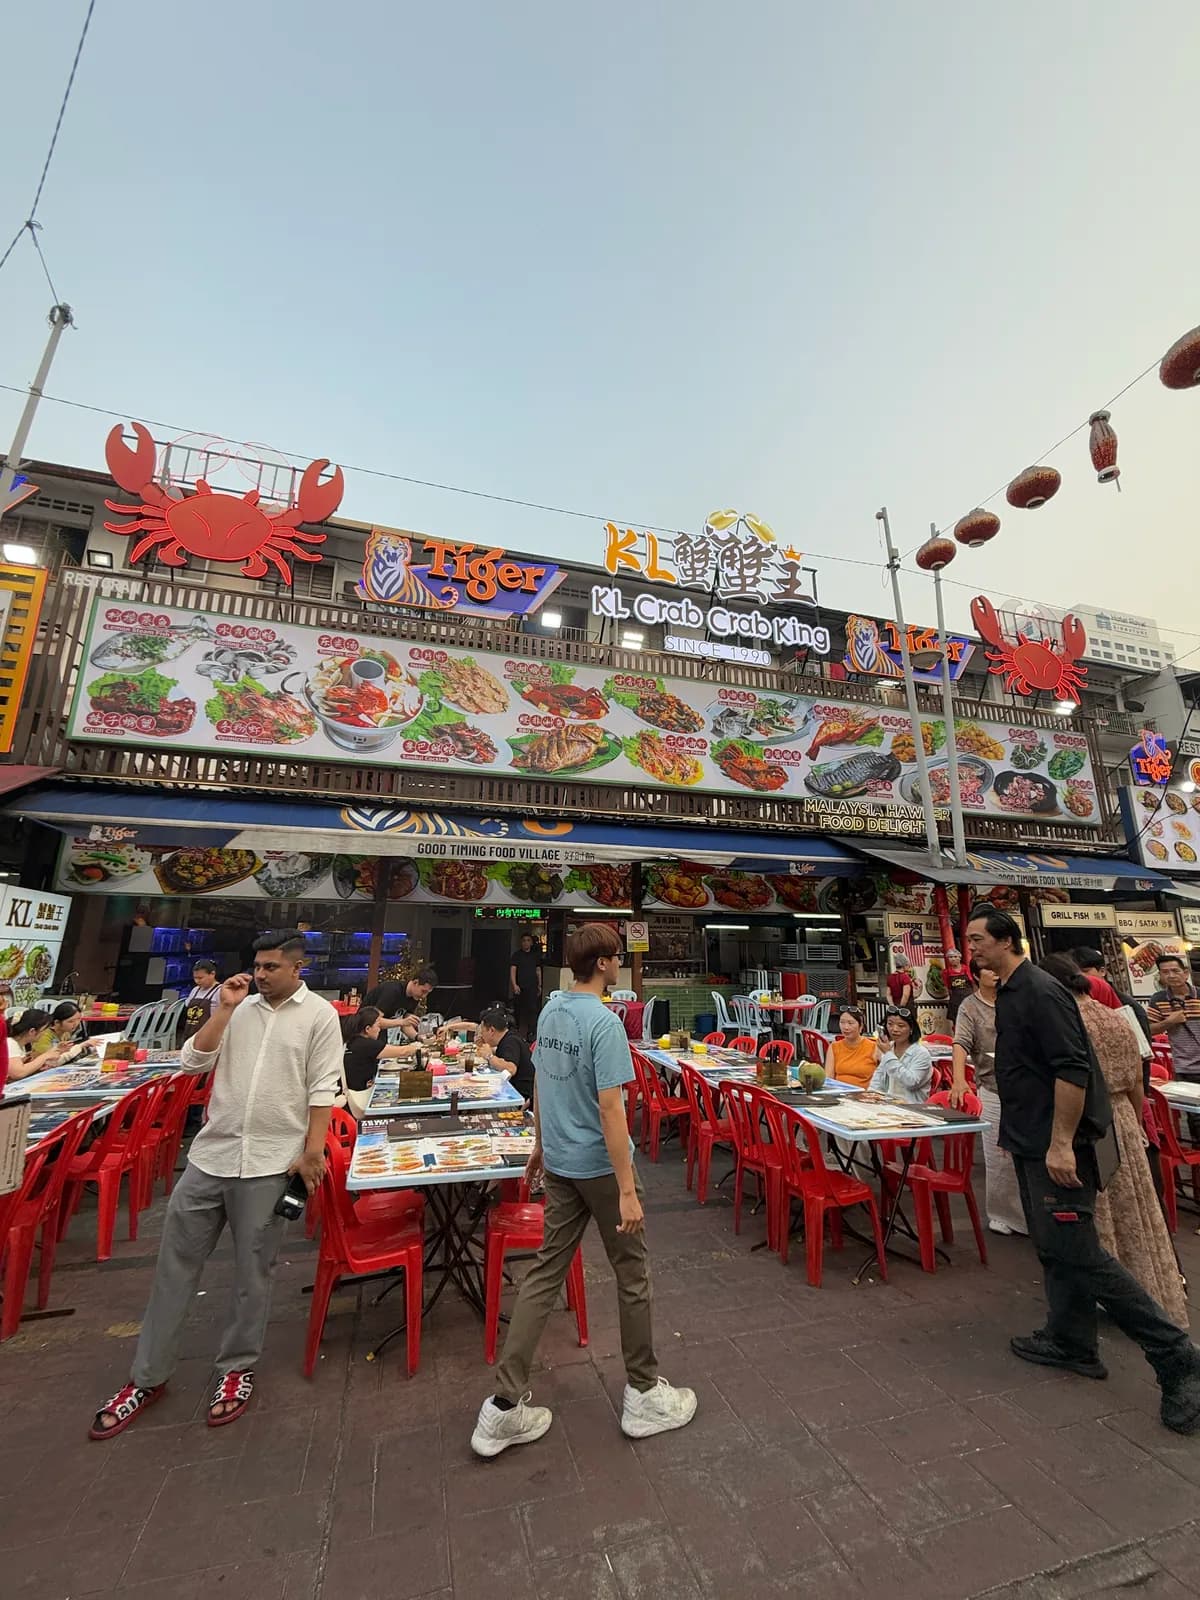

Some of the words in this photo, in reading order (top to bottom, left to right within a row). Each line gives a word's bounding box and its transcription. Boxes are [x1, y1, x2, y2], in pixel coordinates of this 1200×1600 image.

[604, 521, 676, 584] KL
[424, 540, 546, 600] Tiger
[592, 586, 630, 618] KL
[634, 594, 703, 627] Crab
[707, 606, 772, 639] Crab
[773, 616, 830, 654] King
[665, 636, 721, 657] SINCE
[730, 646, 771, 665] 1990
[1137, 757, 1172, 782] Tiger
[805, 799, 883, 816] MALAYSIA
[887, 804, 950, 820] HAWER
[104, 826, 139, 841] Tiger
[820, 815, 864, 831] FOOD
[417, 842, 447, 856] GOOD
[450, 844, 487, 857] TIMING
[489, 846, 516, 859] FOOD
[519, 848, 560, 861] VILLAGE
[1016, 875, 1038, 884] TIMING
[1040, 876, 1055, 885] FOOD
[1056, 877, 1082, 887] VILLAGE
[6, 898, 32, 928] KL
[1051, 911, 1072, 920] GRILL
[1073, 912, 1089, 920] FISH
[1119, 919, 1133, 927] BBQ
[1140, 920, 1159, 928] SATAY
